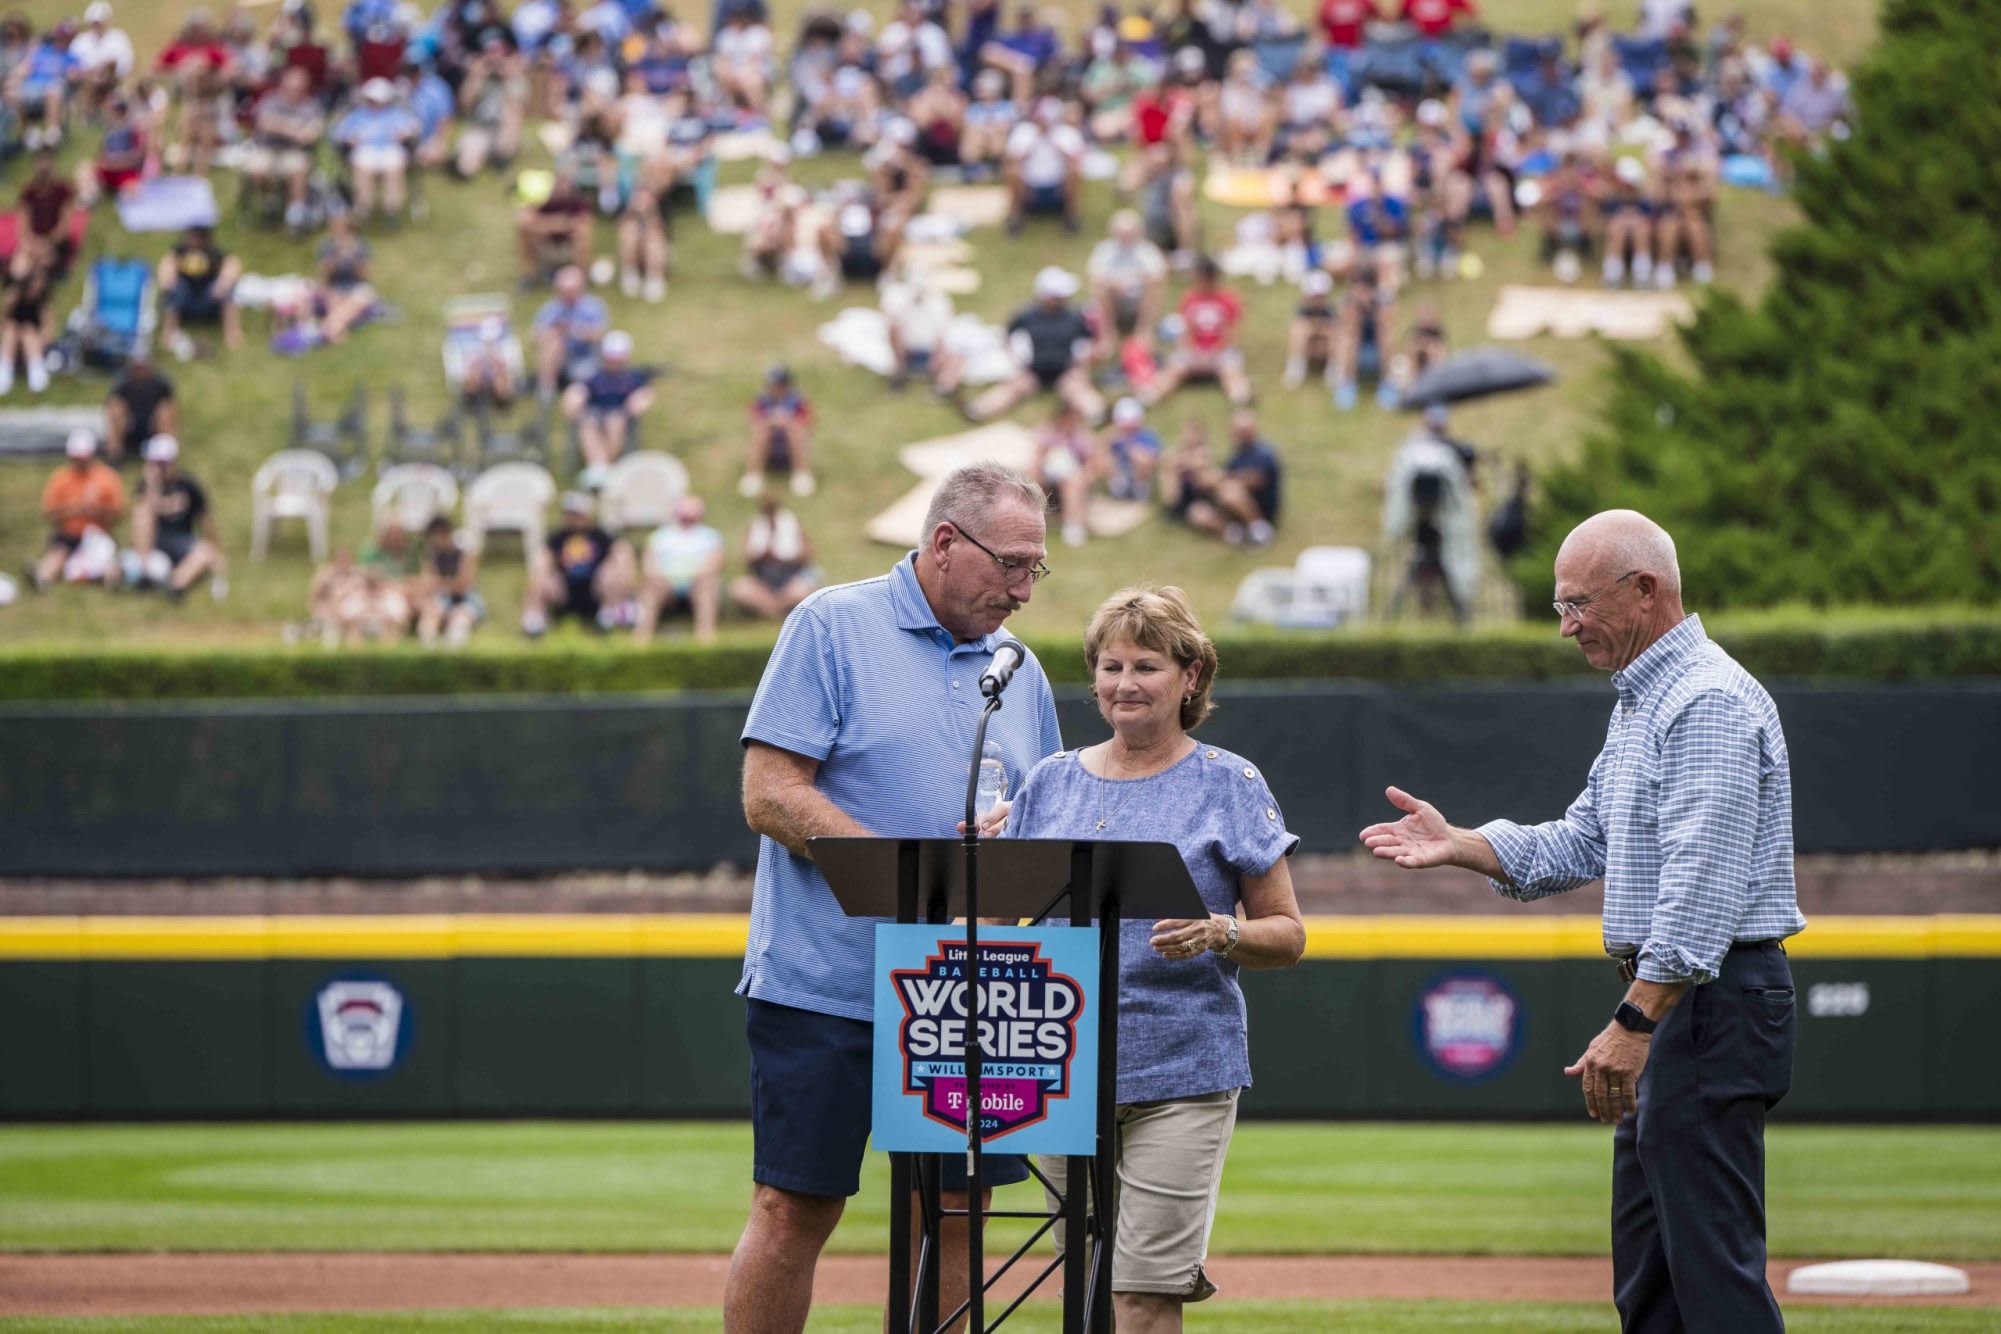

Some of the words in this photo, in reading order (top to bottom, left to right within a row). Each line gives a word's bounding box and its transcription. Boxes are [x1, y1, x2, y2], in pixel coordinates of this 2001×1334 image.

[948, 949, 979, 960] Litt
[983, 950, 1030, 964] League
[939, 966, 1038, 978] BAEBALL
[902, 979, 1075, 1018] WORLD
[908, 1018, 1067, 1059] SERIES
[928, 1064, 1045, 1076] WILLMSPORT
